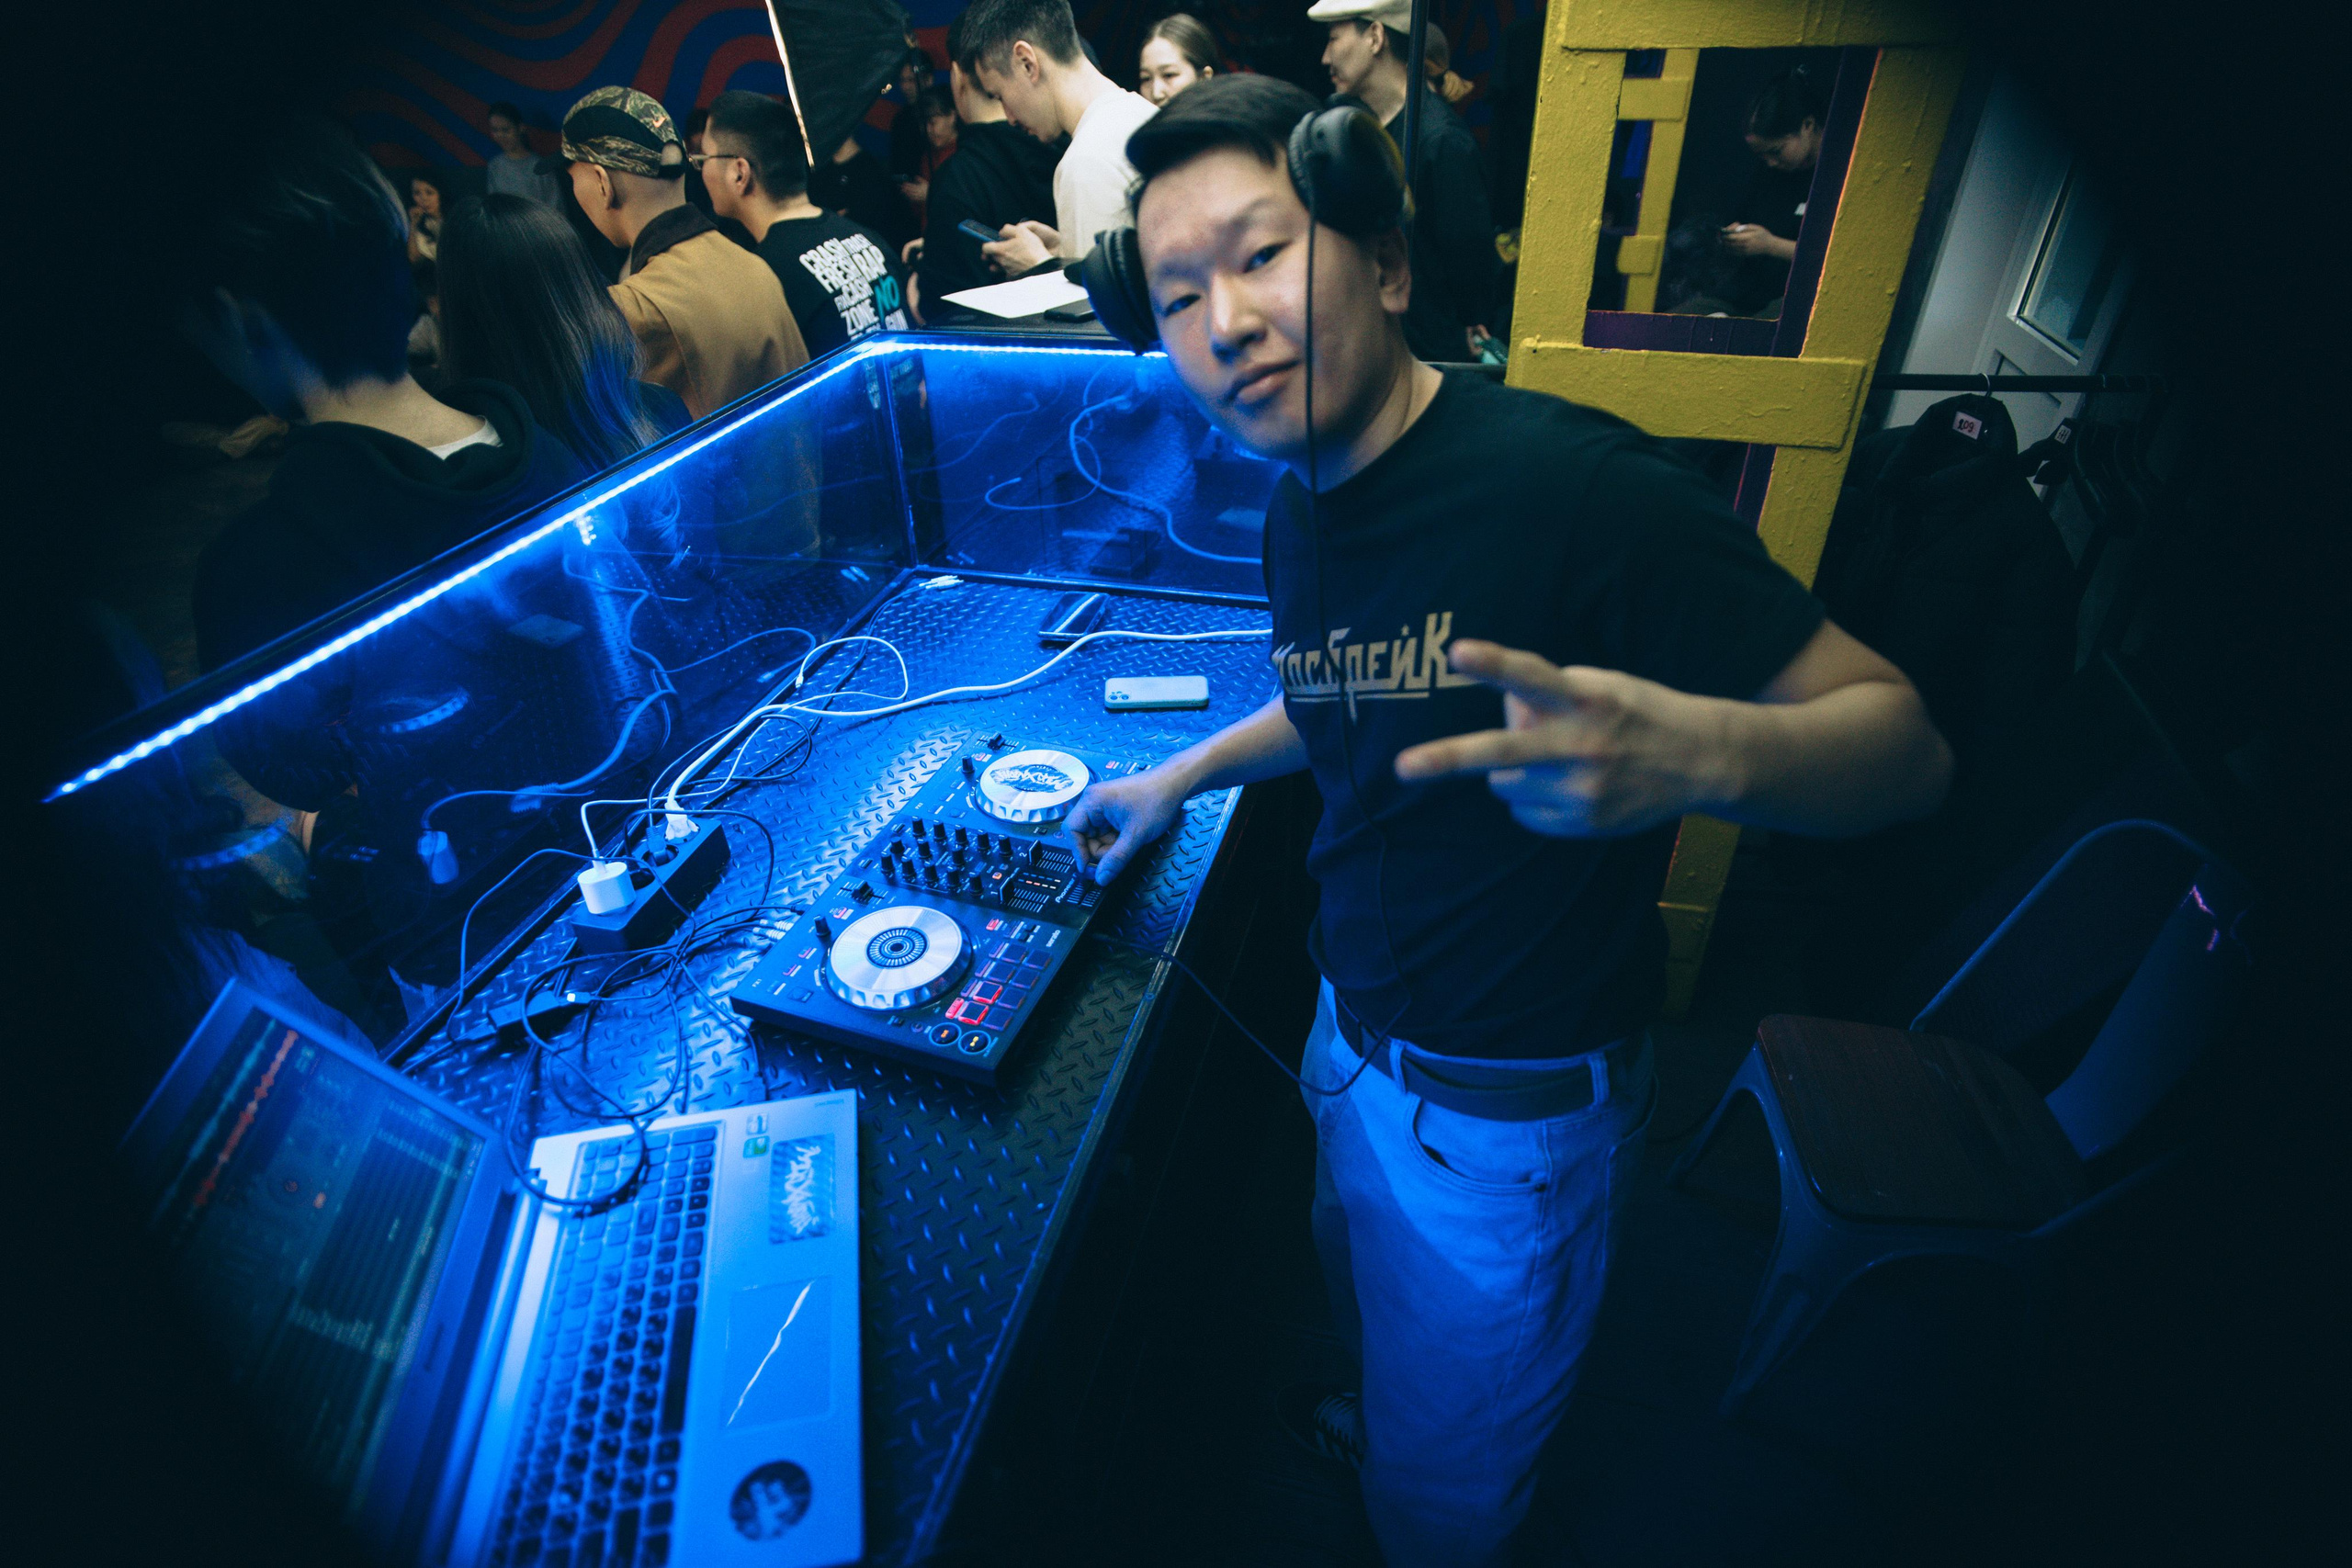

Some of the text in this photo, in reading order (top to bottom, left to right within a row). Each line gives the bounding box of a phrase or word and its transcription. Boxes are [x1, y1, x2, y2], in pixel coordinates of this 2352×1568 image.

[799, 237, 848, 275] CRASH
[814, 245, 888, 294] FRESH RAP
[841, 299, 879, 336] ZONE
[874, 276, 900, 321] NO
[1055, 876, 1074, 904] Pioneer
[1046, 929, 1061, 948] serato
